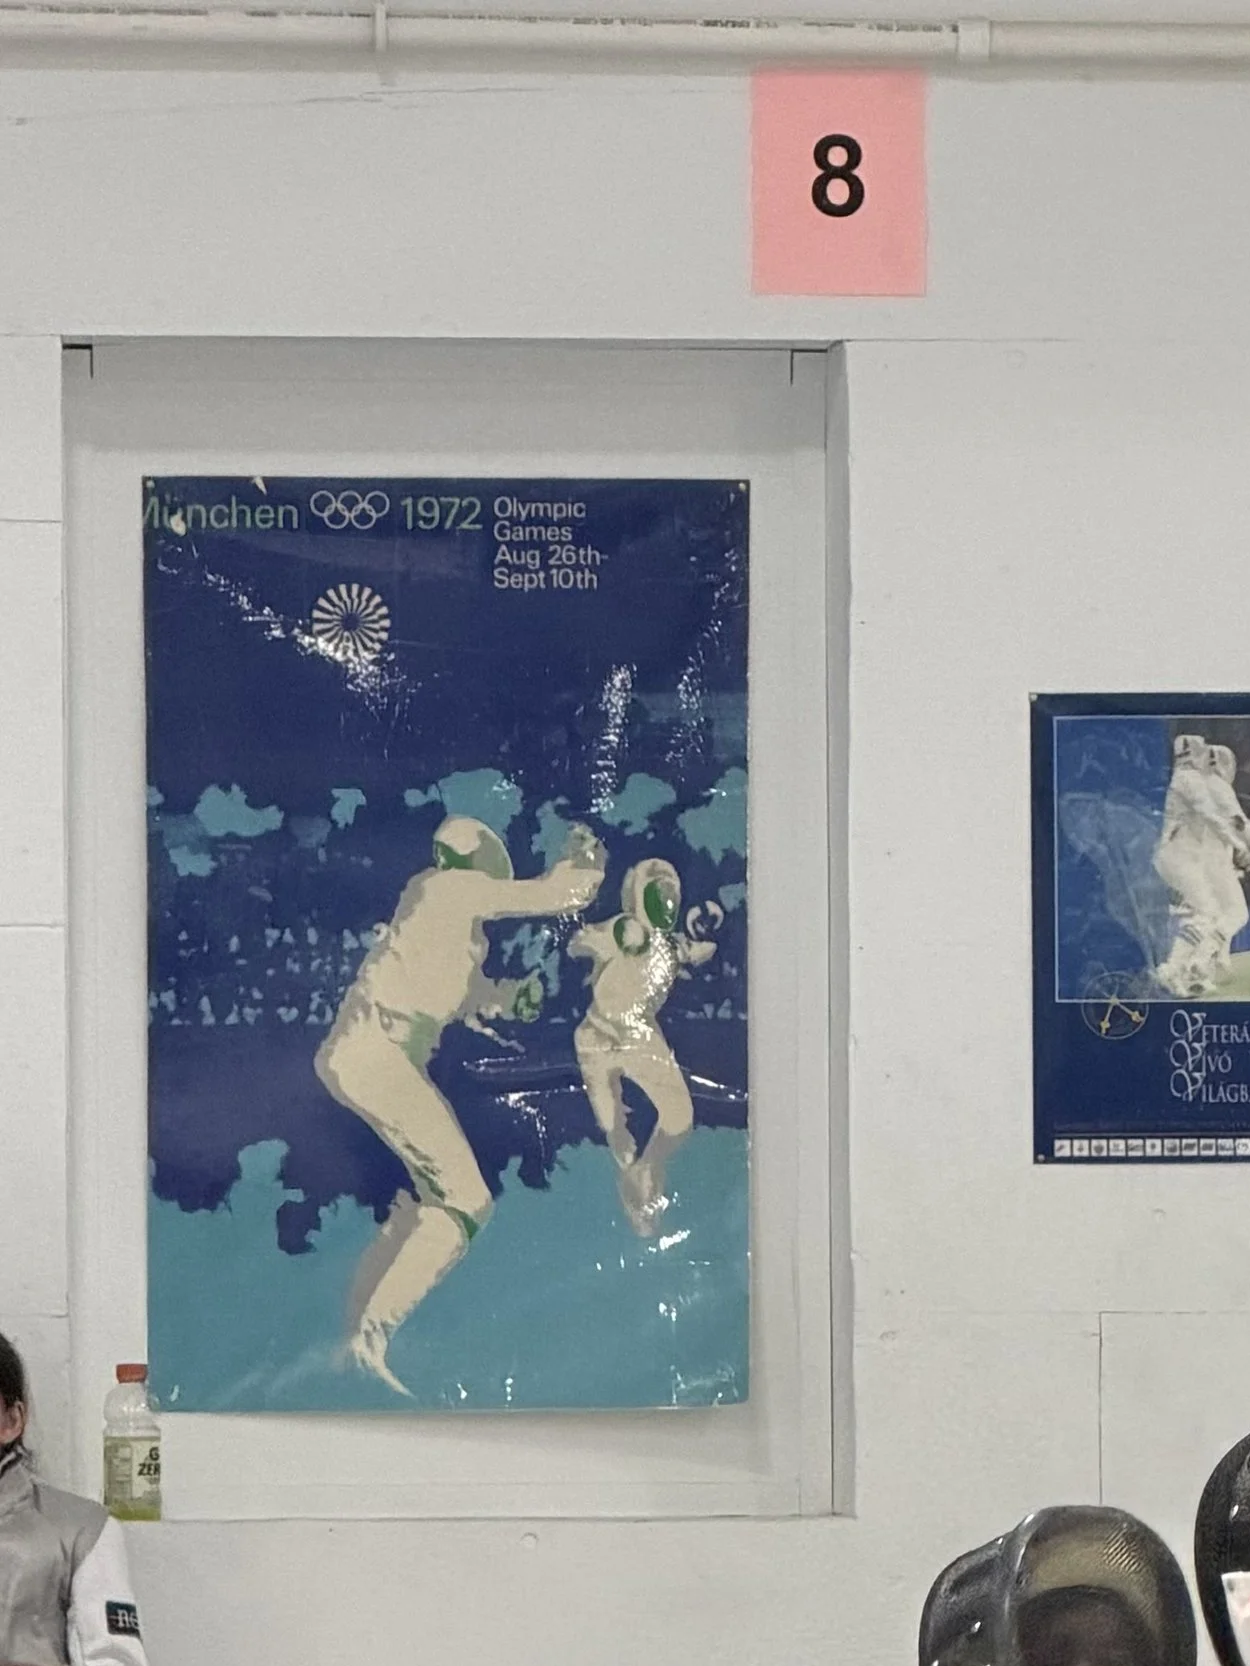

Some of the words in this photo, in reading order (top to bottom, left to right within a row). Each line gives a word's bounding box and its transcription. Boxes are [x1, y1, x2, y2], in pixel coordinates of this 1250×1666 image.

[811, 133, 866, 219] 8
[401, 496, 483, 530] 1972
[493, 496, 586, 521] Olympic
[493, 520, 573, 542] Games
[493, 544, 541, 569] Aug
[493, 567, 546, 592] Sept
[551, 568, 598, 589] 10th
[149, 1446, 160, 1461] G
